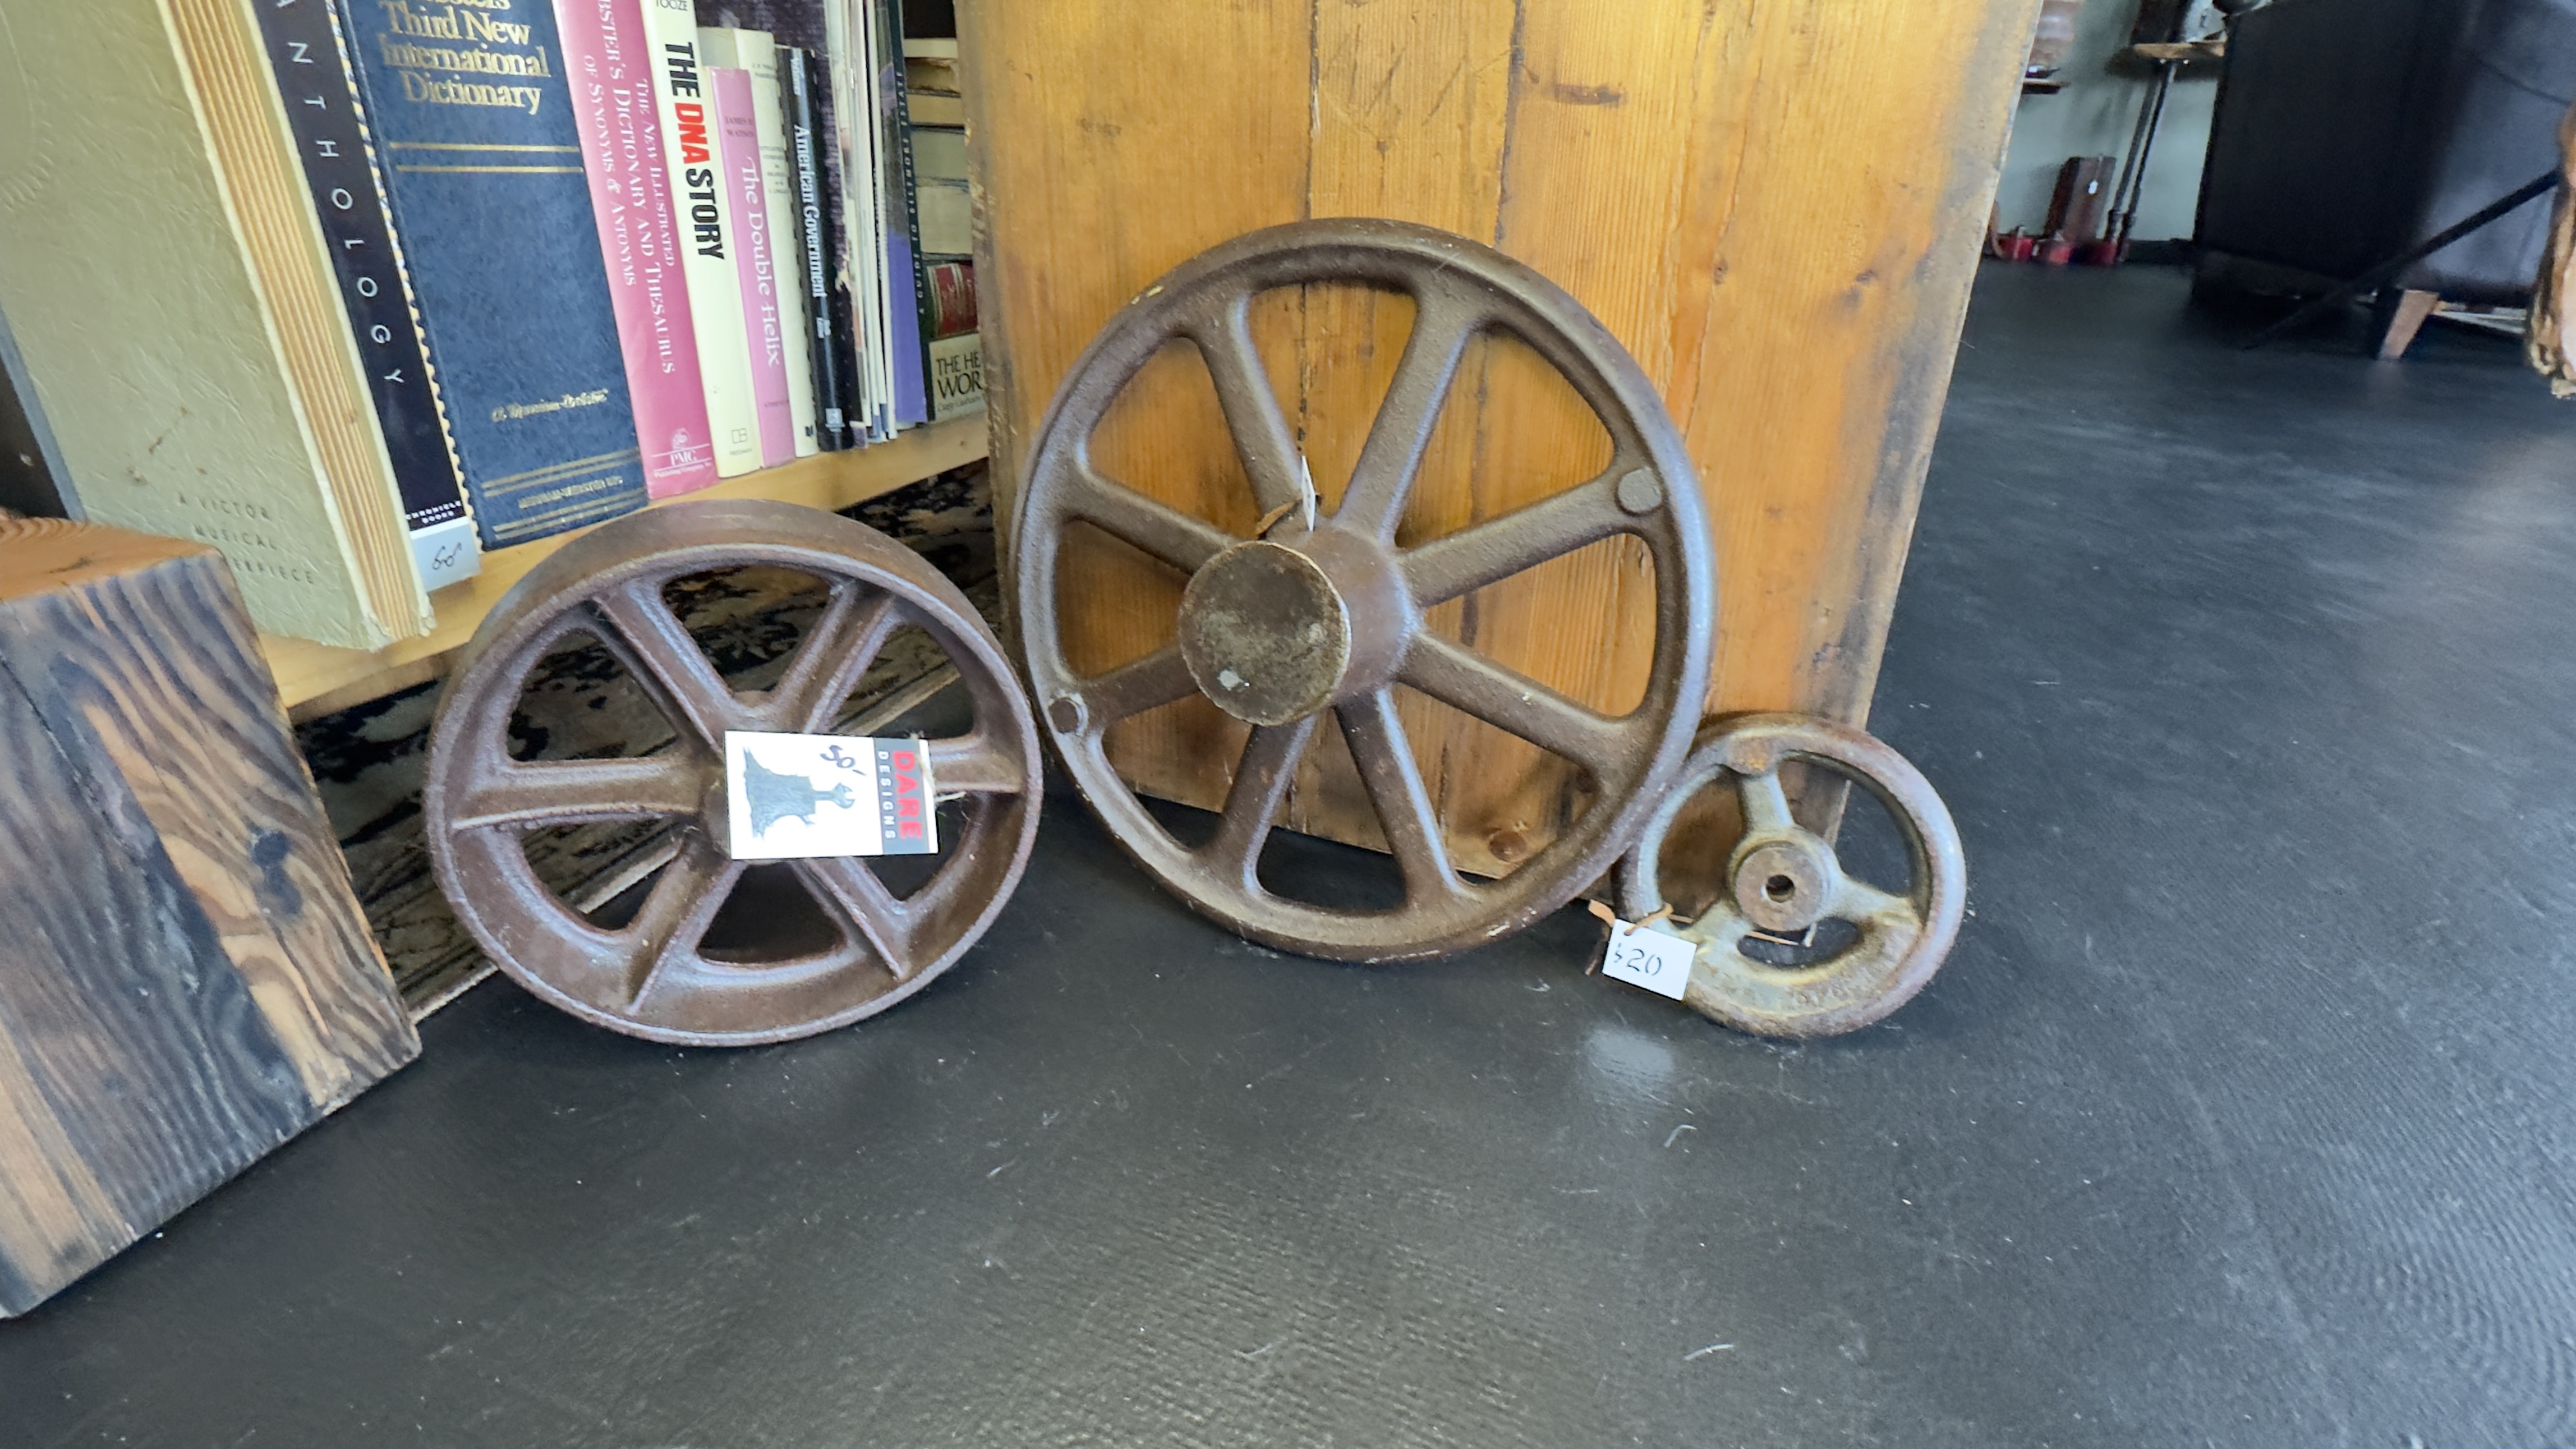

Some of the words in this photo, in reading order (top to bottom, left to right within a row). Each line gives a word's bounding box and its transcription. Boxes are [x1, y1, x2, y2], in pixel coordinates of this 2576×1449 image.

[381, 1, 463, 39] Third
[460, 10, 531, 45] New
[378, 34, 551, 77] International
[584, 55, 599, 78] OF
[665, 42, 702, 98] THE
[399, 70, 542, 115] Dictionary
[636, 78, 650, 114] THE
[588, 82, 615, 172] SYNONYMS
[641, 119, 658, 163] NEW
[675, 102, 710, 164] DNA
[277, 0, 404, 383] NTHOLOGY
[607, 178, 622, 194] &
[741, 155, 760, 205] The
[793, 125, 815, 203] American
[610, 201, 637, 286] ANTONYMS
[613, 88, 647, 210] DICTIONARY
[636, 217, 654, 256] AND
[645, 261, 675, 373] THESAURUS
[650, 167, 675, 266] ILLUSTRATED
[686, 168, 725, 260] STORY
[747, 211, 771, 296] Double
[803, 205, 827, 298] Government
[761, 301, 781, 368] Helix
[936, 355, 960, 376] THE
[178, 491, 188, 506] A
[197, 495, 270, 521] VICTOR
[194, 523, 277, 551] MUSICAL
[878, 751, 896, 839] DESIGNS
[893, 750, 923, 840] DARE
[1613, 942, 1662, 976] $20
